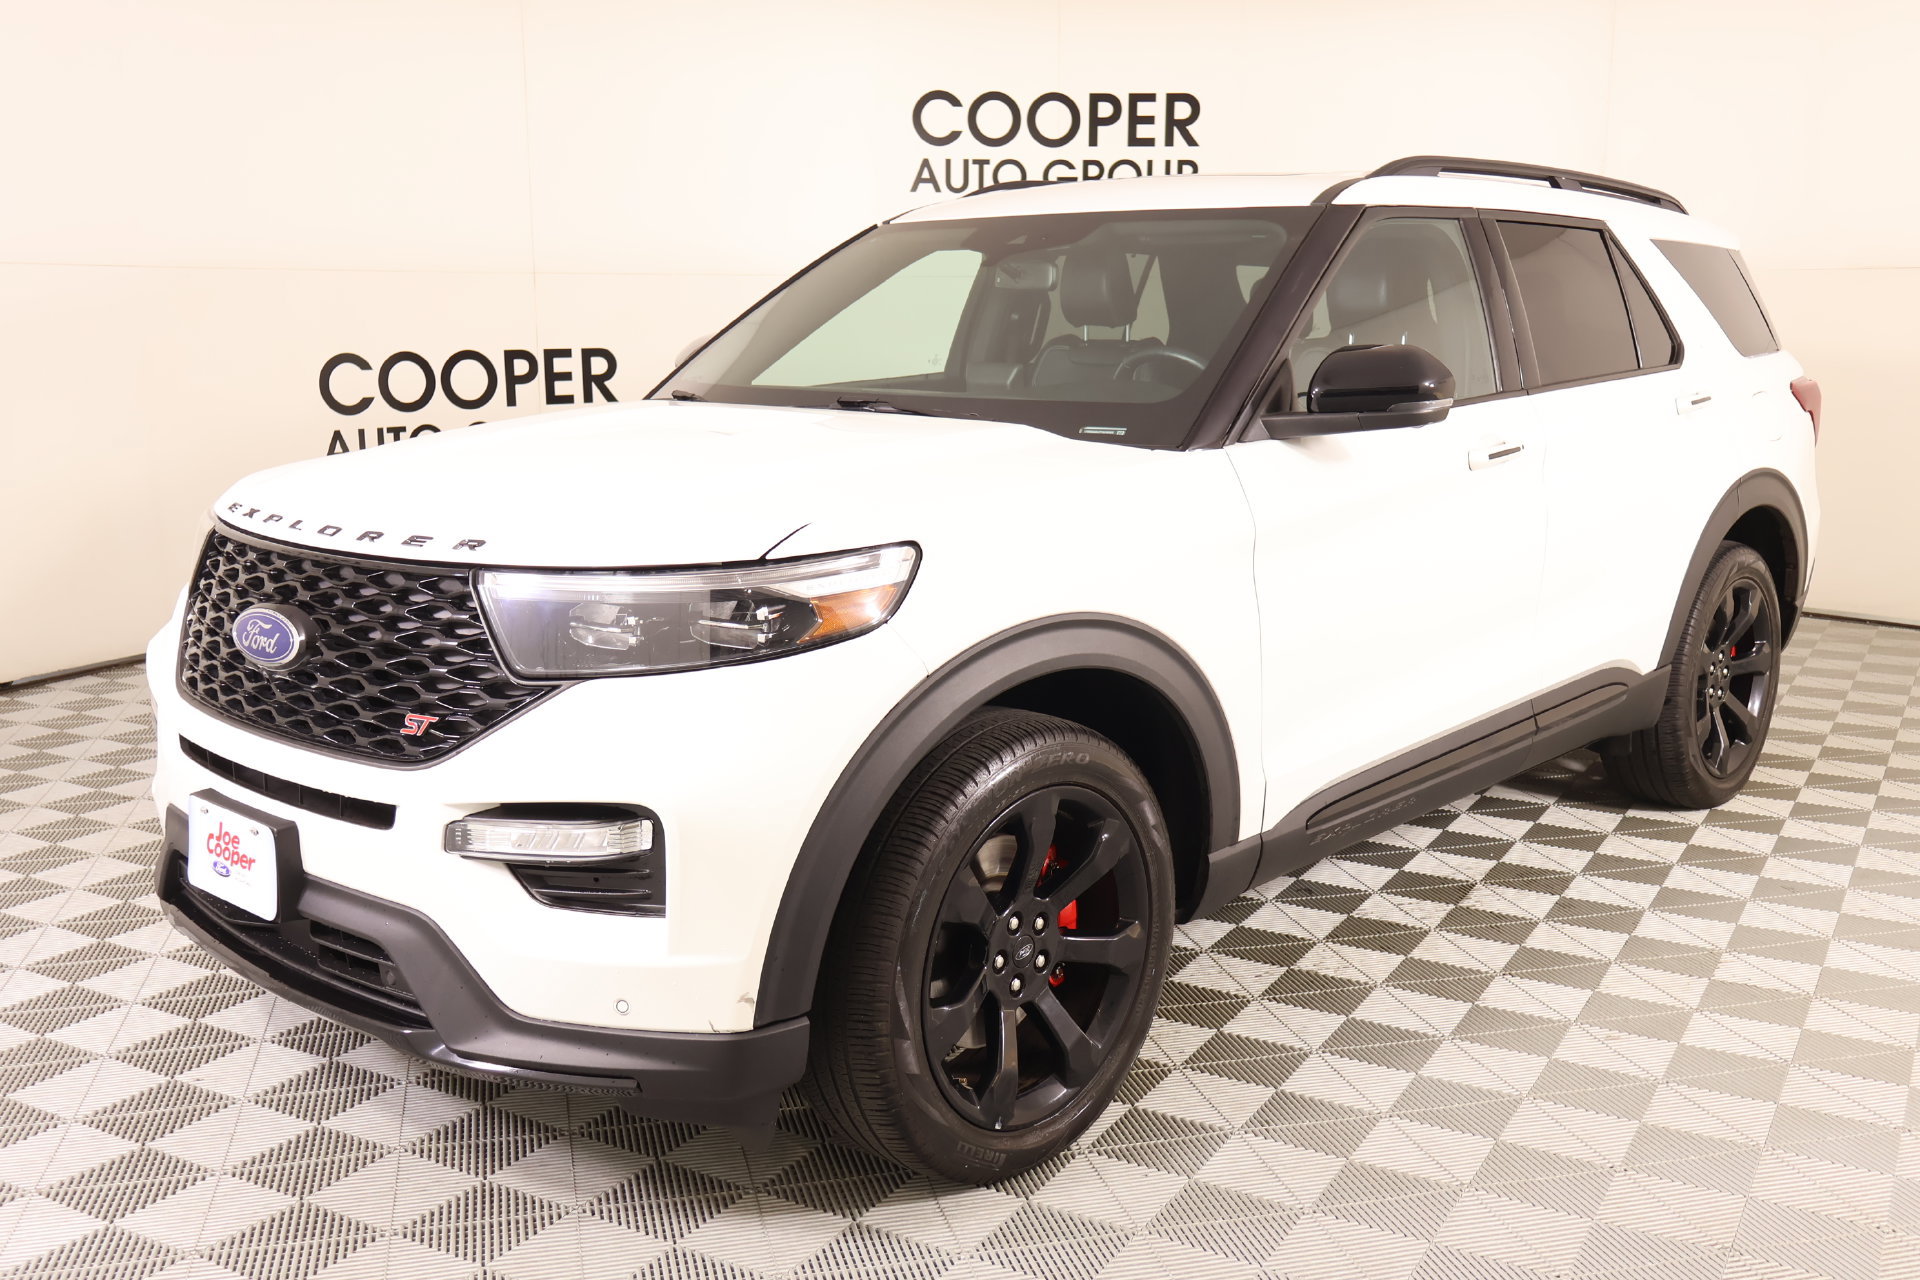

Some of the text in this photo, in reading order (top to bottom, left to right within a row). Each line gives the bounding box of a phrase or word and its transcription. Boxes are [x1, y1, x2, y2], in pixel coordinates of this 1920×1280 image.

[912, 90, 1201, 147] COOPER
[910, 158, 1027, 193] AUTO
[319, 348, 619, 416] COOPER
[228, 502, 487, 551] EXPLORER
[242, 618, 280, 654] Ford
[400, 714, 439, 736] ST
[207, 833, 256, 871] Cooper
[215, 821, 240, 849] Joe
